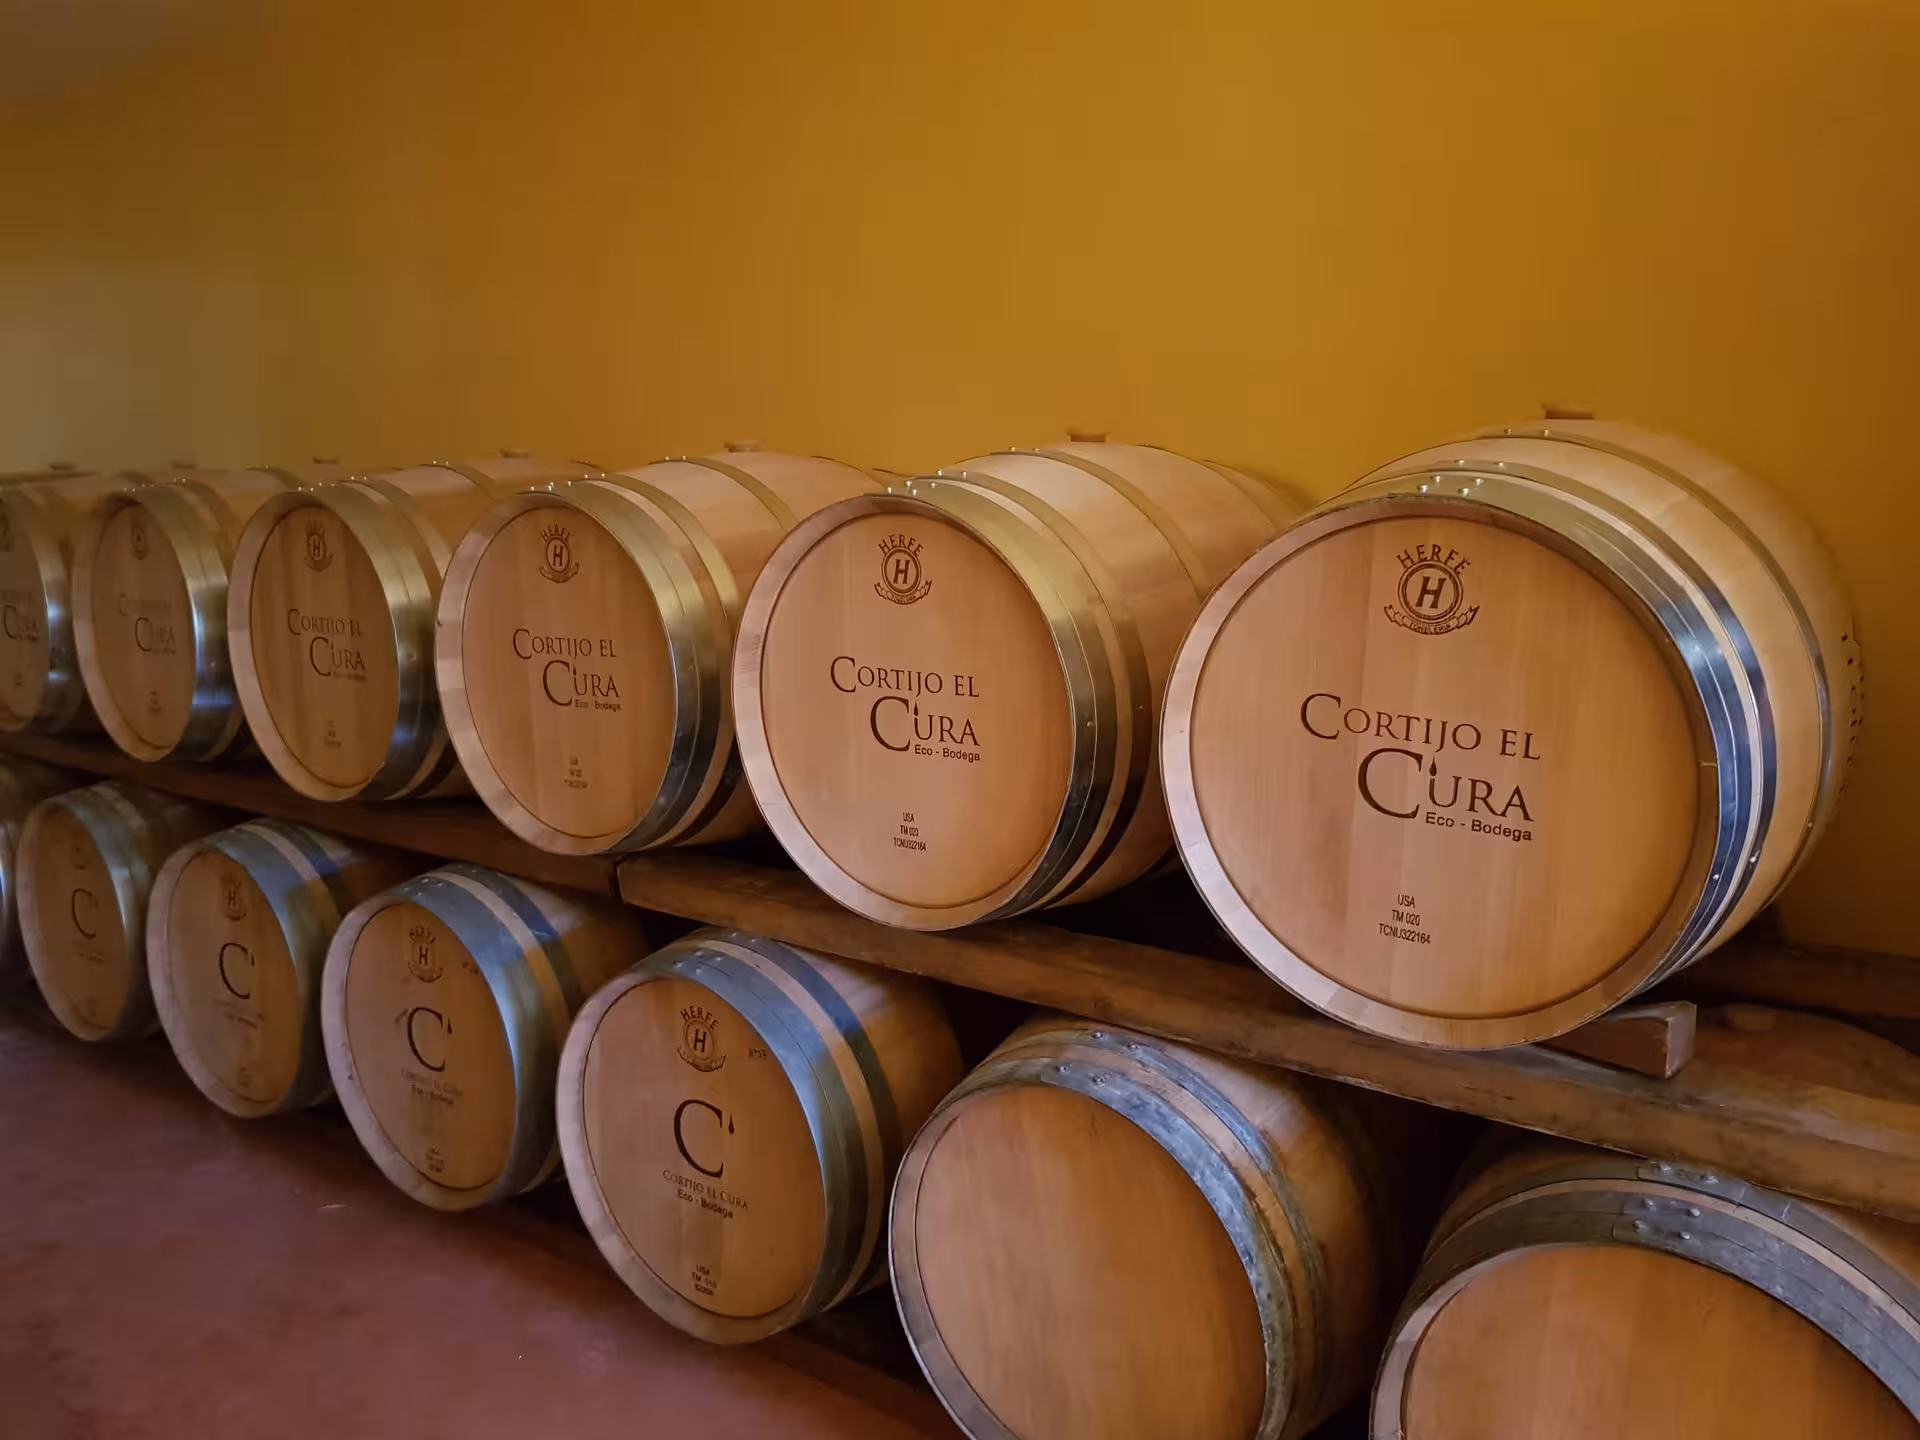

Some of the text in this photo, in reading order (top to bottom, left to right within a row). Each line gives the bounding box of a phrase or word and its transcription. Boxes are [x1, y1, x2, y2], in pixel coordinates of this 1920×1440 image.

[552, 545, 564, 566] H
[878, 533, 924, 557] HERFE
[1396, 543, 1471, 575] HERFE
[893, 558, 910, 584] H
[1415, 575, 1447, 609] H
[310, 636, 366, 677] CURA
[513, 628, 617, 660] CORTIJO EL
[543, 660, 620, 706] CURA
[830, 656, 980, 698] CORTIJO EL
[870, 695, 980, 752] CURA
[1300, 693, 1541, 761] CORTIJO EL
[914, 744, 933, 756] Eco
[943, 747, 981, 763] Bodega
[1358, 747, 1535, 822] CURA
[1425, 811, 1455, 828] Eco
[1471, 819, 1533, 842] Bodega
[1397, 894, 1415, 908] USA
[1392, 909, 1421, 926] TM 020
[219, 942, 250, 999] C
[419, 945, 428, 966] H
[680, 1005, 719, 1031] HERFE
[407, 1007, 446, 1072] C
[694, 1029, 707, 1052] H
[674, 1099, 724, 1178] C
[720, 1190, 748, 1209] CURA
